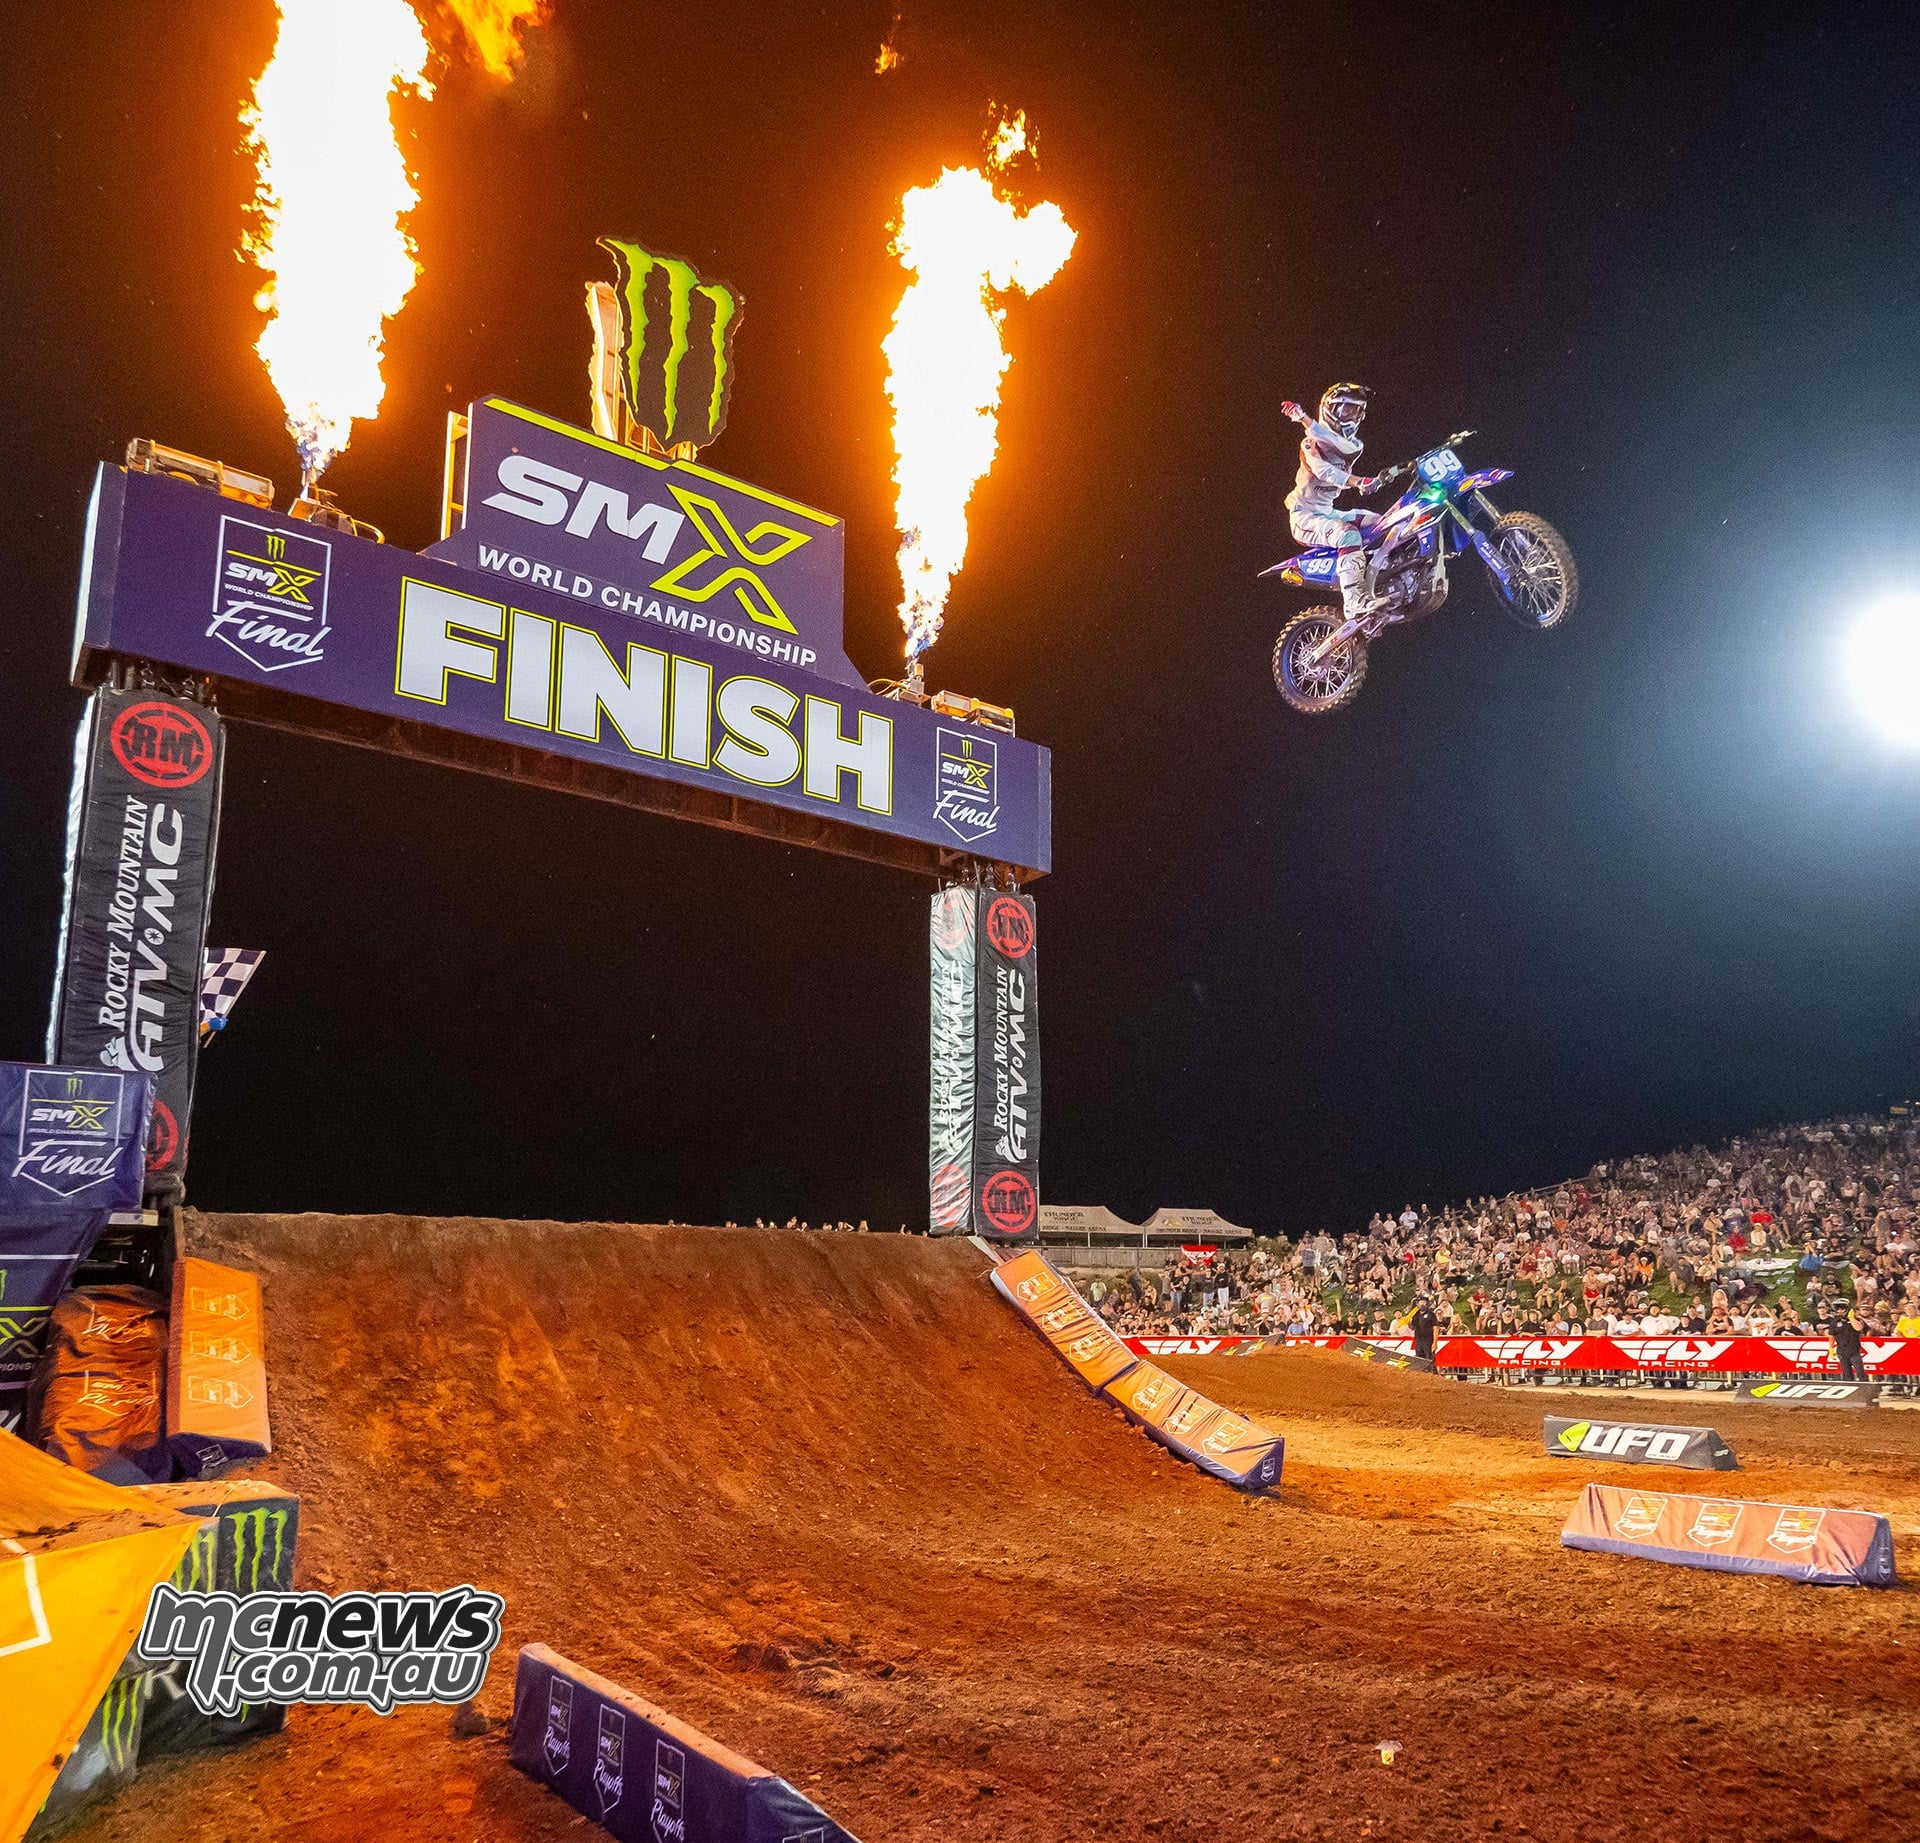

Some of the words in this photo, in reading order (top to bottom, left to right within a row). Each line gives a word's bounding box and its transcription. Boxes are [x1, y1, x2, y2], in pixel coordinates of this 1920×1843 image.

[1422, 449, 1462, 482] 99
[482, 455, 813, 635] SMX
[225, 562, 316, 603] SMX
[1306, 558, 1334, 575] 99
[224, 583, 254, 595] WORLD
[254, 592, 314, 610] CHAMPIONSHIP
[478, 545, 594, 598] WORLD
[600, 586, 817, 668] CHAMPIONSHIP
[205, 600, 332, 656] Final
[395, 577, 894, 816] FINISH
[124, 718, 202, 770] RM
[941, 761, 990, 789] SMX
[932, 790, 1000, 829] Final
[107, 795, 149, 942] MOUNTAIN
[99, 942, 132, 1032] ROCKY
[994, 965, 1009, 1068] MOUNTAIN
[29, 1105, 109, 1129] SMX
[994, 1067, 1008, 1132] ROCKY
[11, 1139, 124, 1177] Final
[1139, 1340, 1223, 1354] FLY
[1474, 1340, 1585, 1360] FLY
[1611, 1340, 1735, 1361] FLY
[1795, 1362, 1876, 1371] RACG
[1766, 1384, 1860, 1399] UFO
[1579, 1425, 1691, 1461] UFO
[593, 1758, 624, 1797] Playoffs
[650, 1798, 686, 1842] Playoffs
